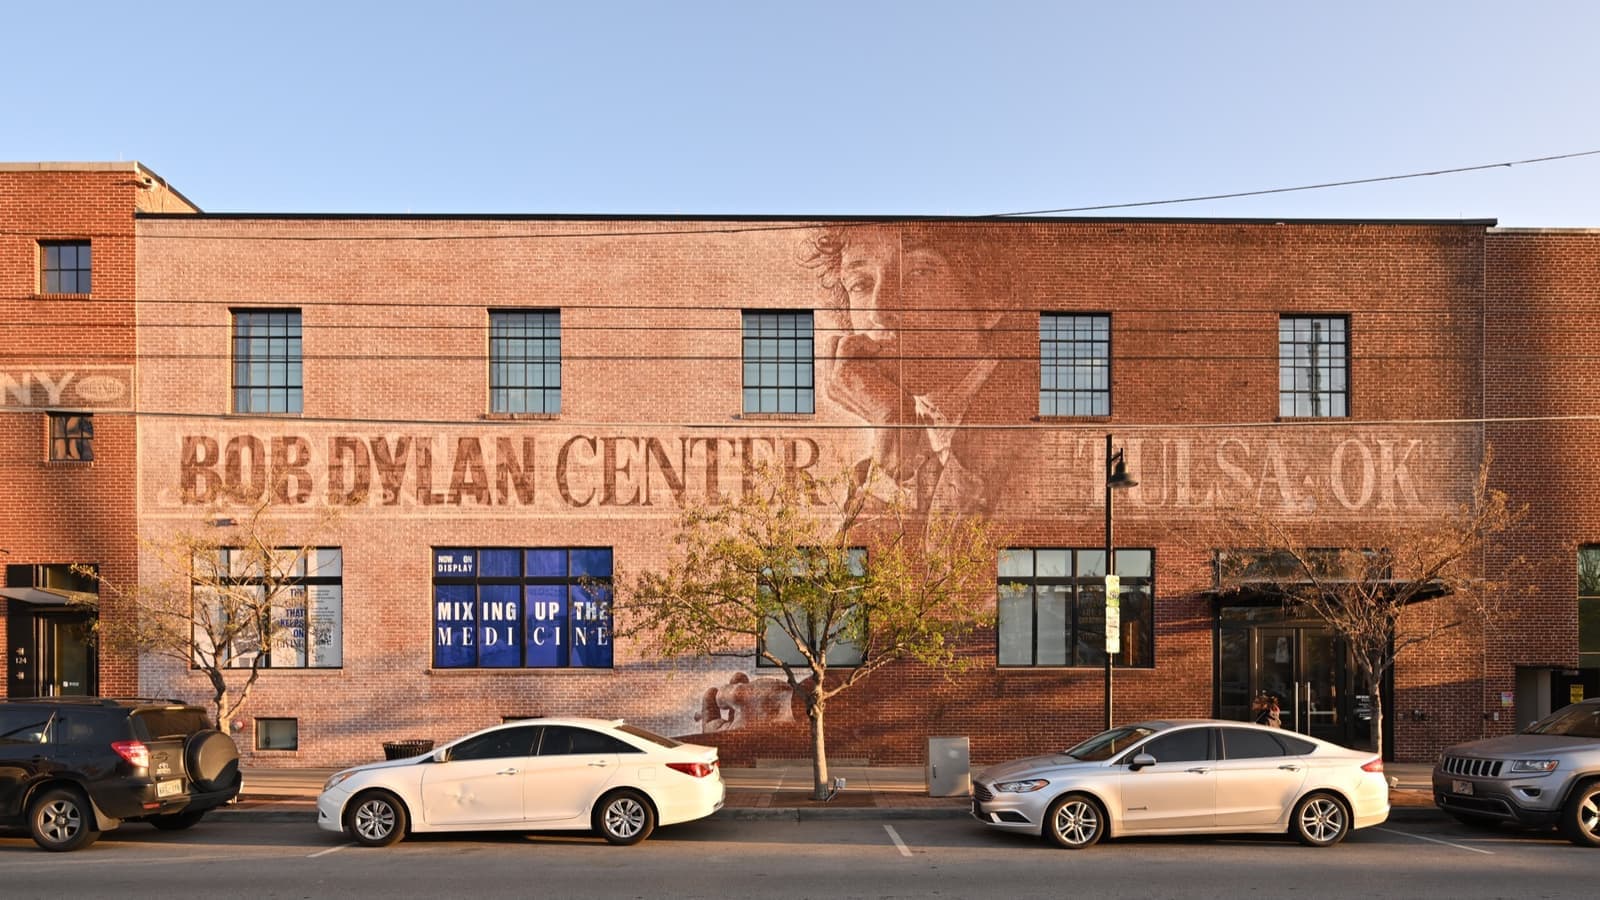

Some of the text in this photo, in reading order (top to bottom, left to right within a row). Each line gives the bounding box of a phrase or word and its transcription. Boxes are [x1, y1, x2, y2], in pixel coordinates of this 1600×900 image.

[181, 435, 827, 508] BOB DYLAN CENTER
[1077, 438, 1427, 510] TULSA OK
[438, 555, 472, 563] NOW ON
[438, 564, 472, 572] DISPLAY
[286, 609, 304, 617] THAT
[438, 602, 609, 621] MIXING UP THE
[293, 629, 304, 638] ON
[438, 627, 608, 645] MEDICINE
